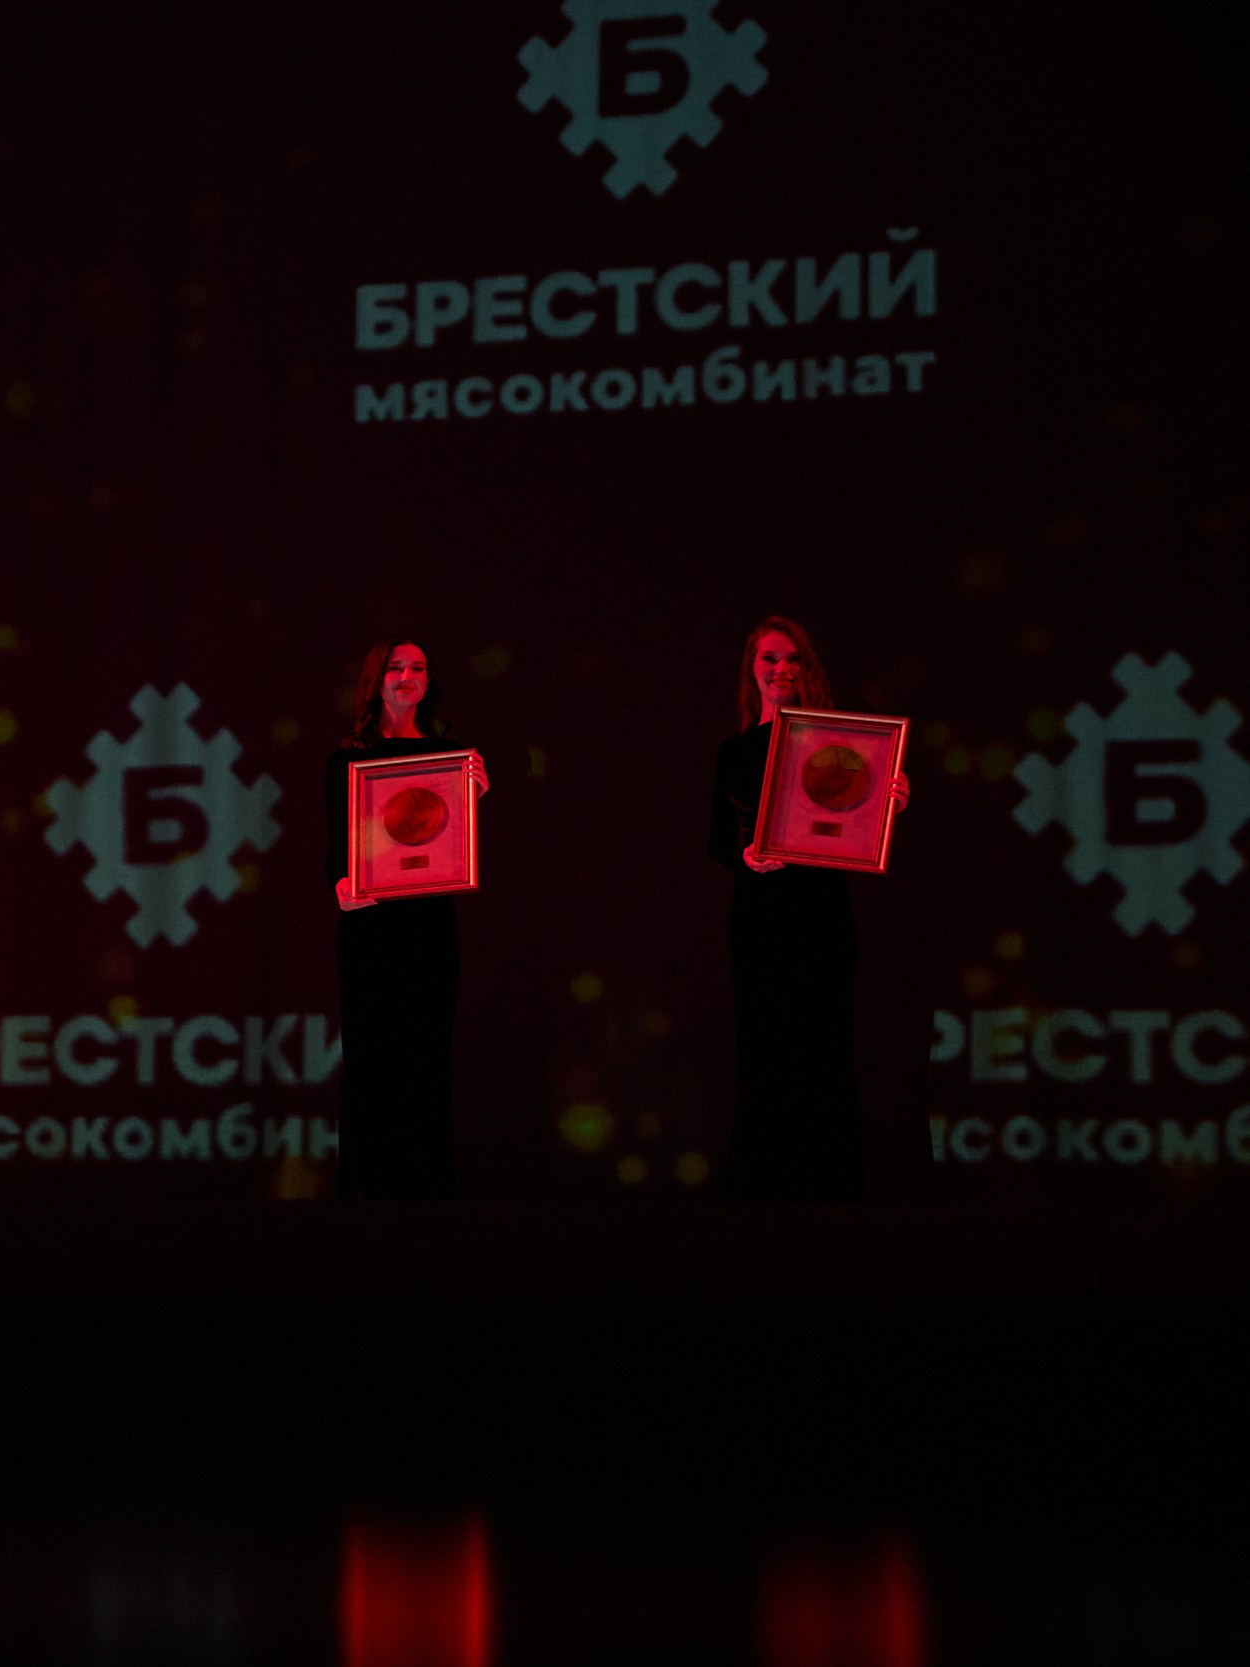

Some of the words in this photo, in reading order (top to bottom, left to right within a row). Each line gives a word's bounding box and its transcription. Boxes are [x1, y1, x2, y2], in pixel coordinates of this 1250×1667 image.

[597, 14, 691, 119] Б
[355, 227, 936, 352] БРЕСТСКИЙ
[354, 344, 936, 423] мясокомбинат
[123, 764, 210, 868] Б
[1103, 738, 1208, 848] Б
[930, 1104, 1250, 1164] сокомб
